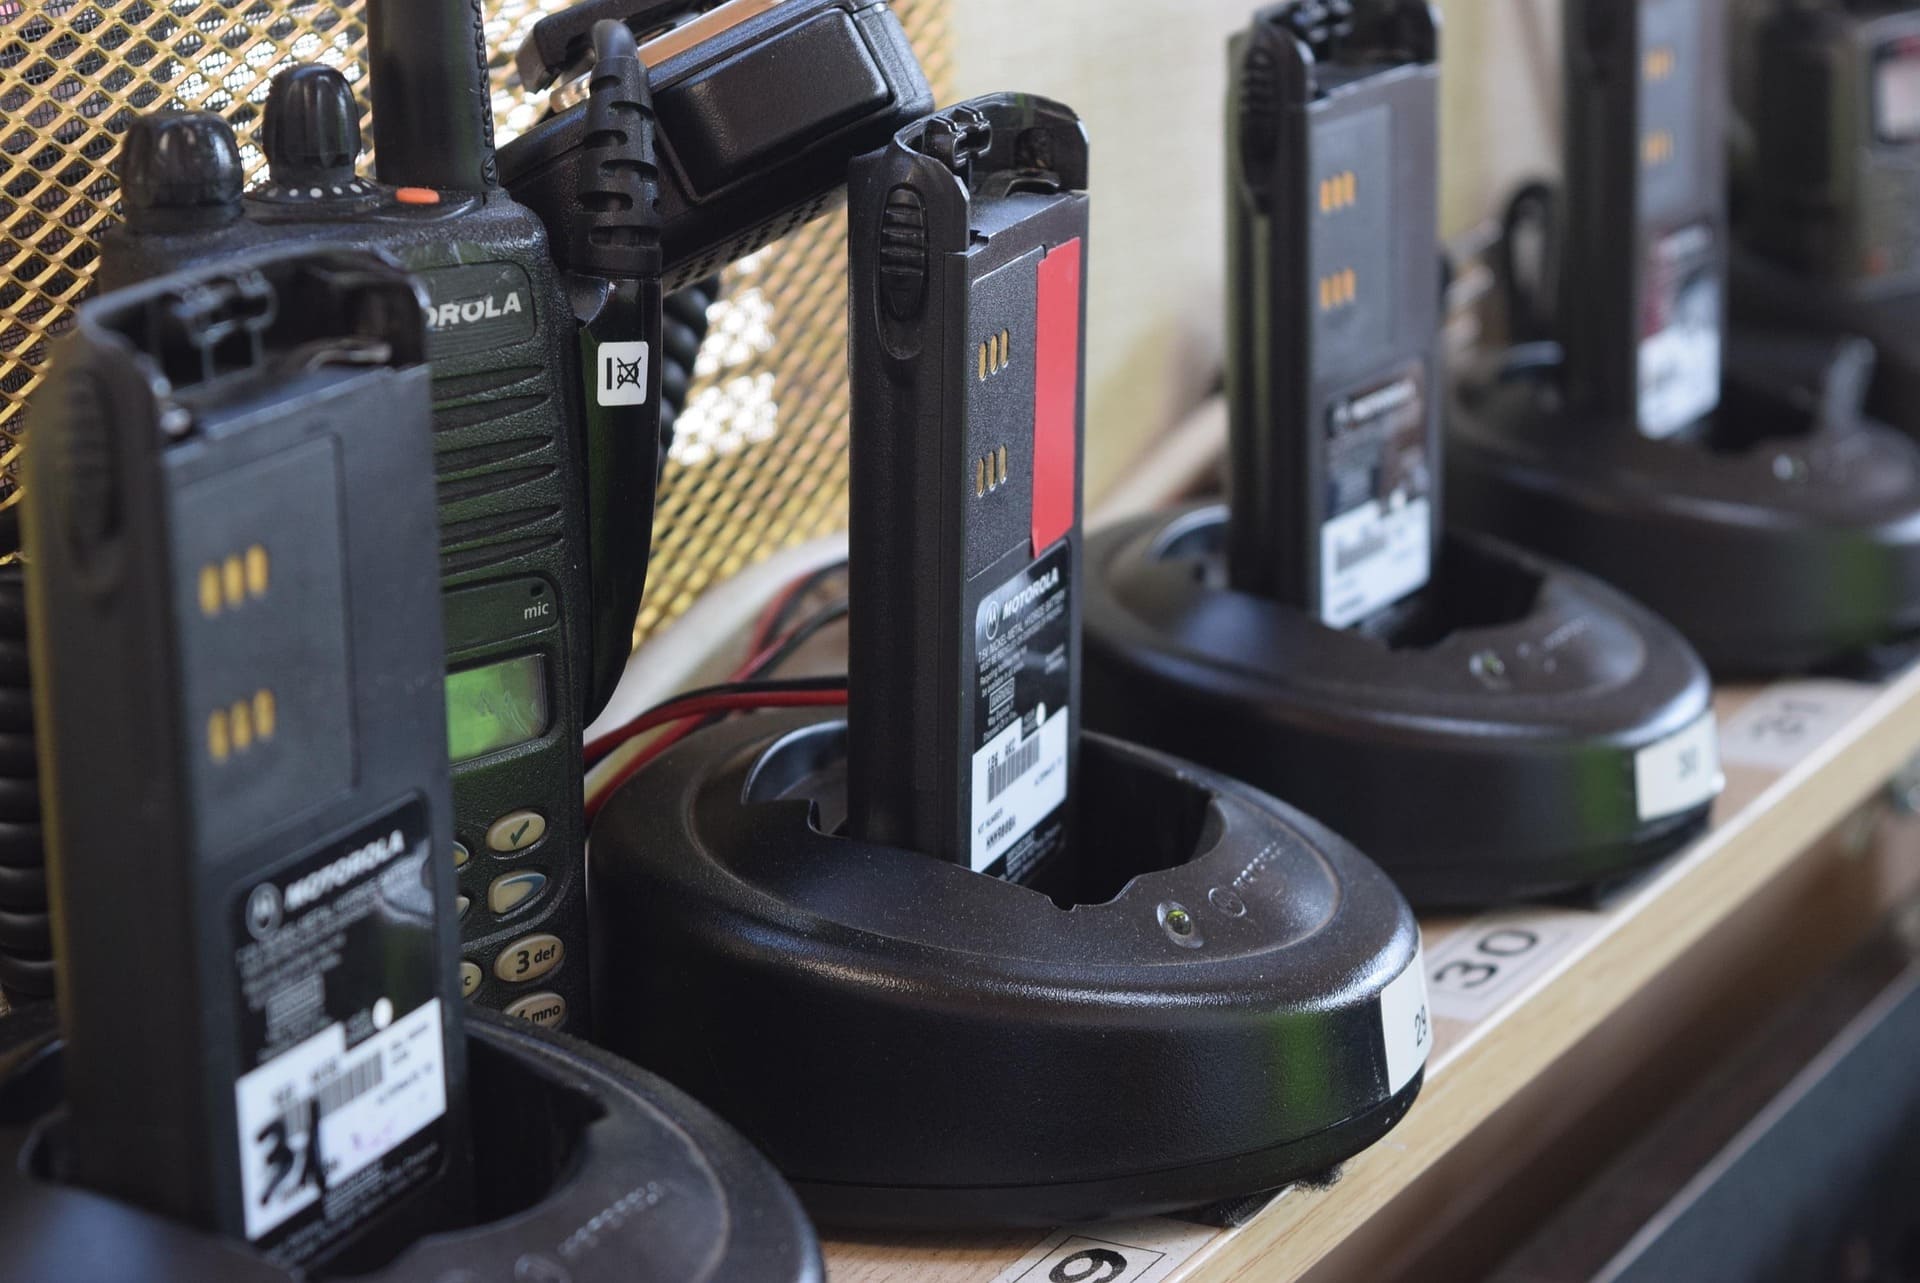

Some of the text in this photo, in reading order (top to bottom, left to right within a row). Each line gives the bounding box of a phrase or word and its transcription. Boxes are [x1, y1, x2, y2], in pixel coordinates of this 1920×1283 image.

[524, 601, 549, 620] mic
[1002, 567, 1059, 621] MOTOROLA
[284, 830, 405, 912] MOTOROLA
[515, 944, 556, 975] 3 def
[1433, 929, 1539, 989] 30
[531, 1005, 561, 1022] mno
[1414, 1004, 1427, 1048] 29
